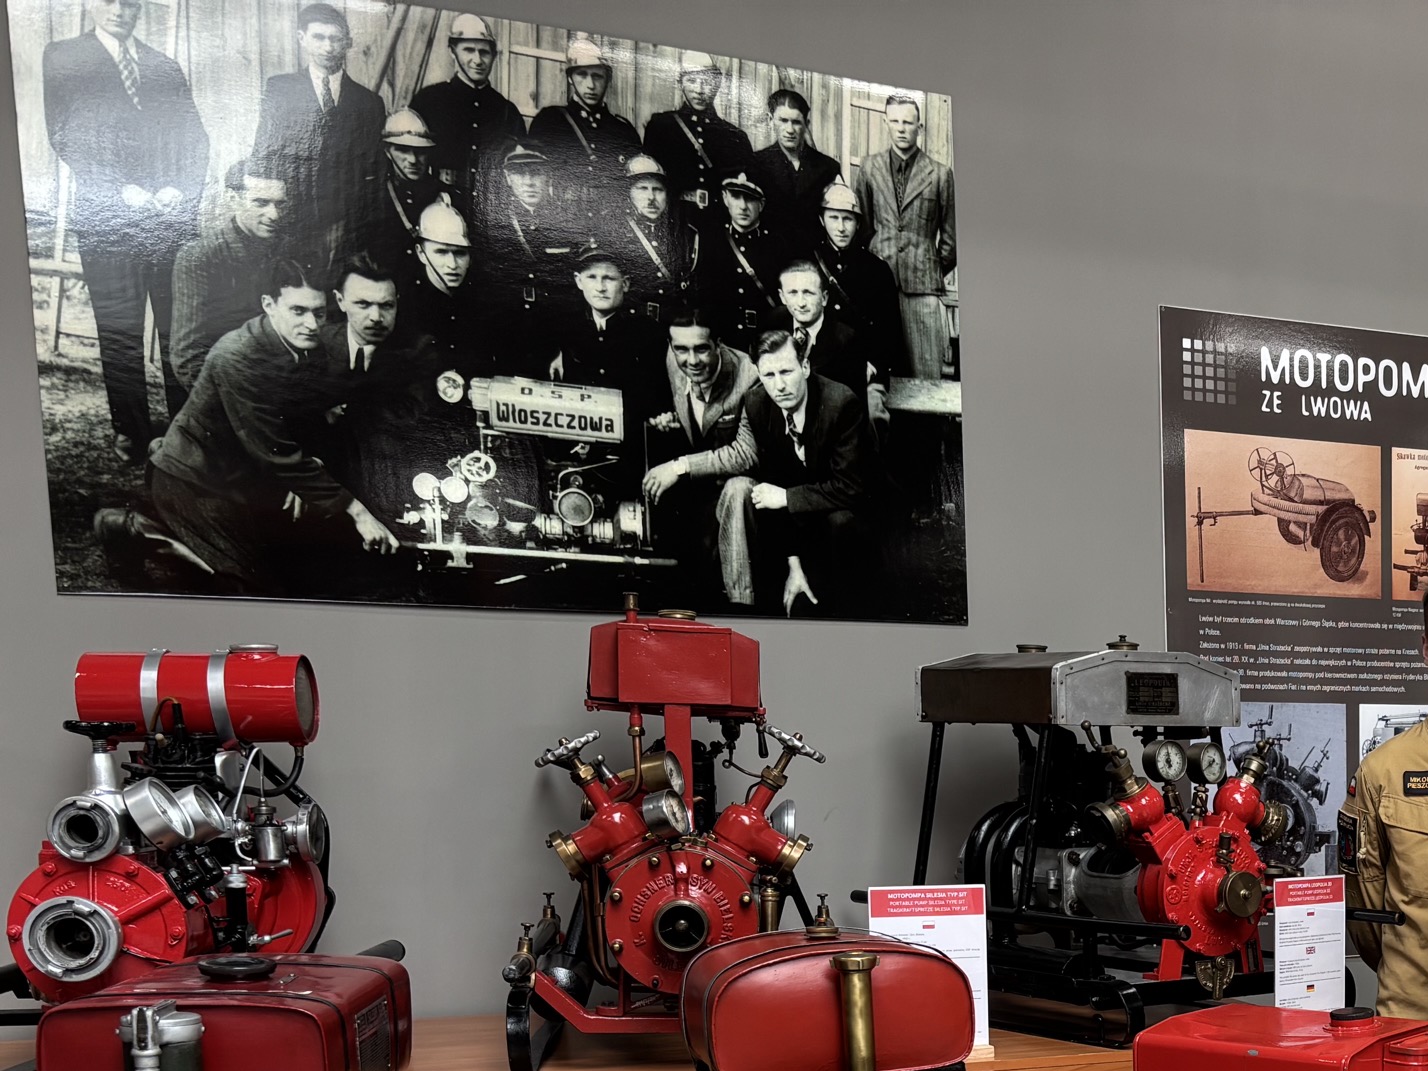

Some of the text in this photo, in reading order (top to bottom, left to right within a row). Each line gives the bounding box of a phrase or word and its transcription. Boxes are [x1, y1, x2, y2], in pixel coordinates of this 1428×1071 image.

[1261, 390, 1372, 421] ZE LWOWA
[496, 400, 614, 433] Włoszczowa
[1276, 618, 1299, 626] Warszawy
[1303, 619, 1321, 627] Górnego
[1289, 671, 1315, 679] motopompy
